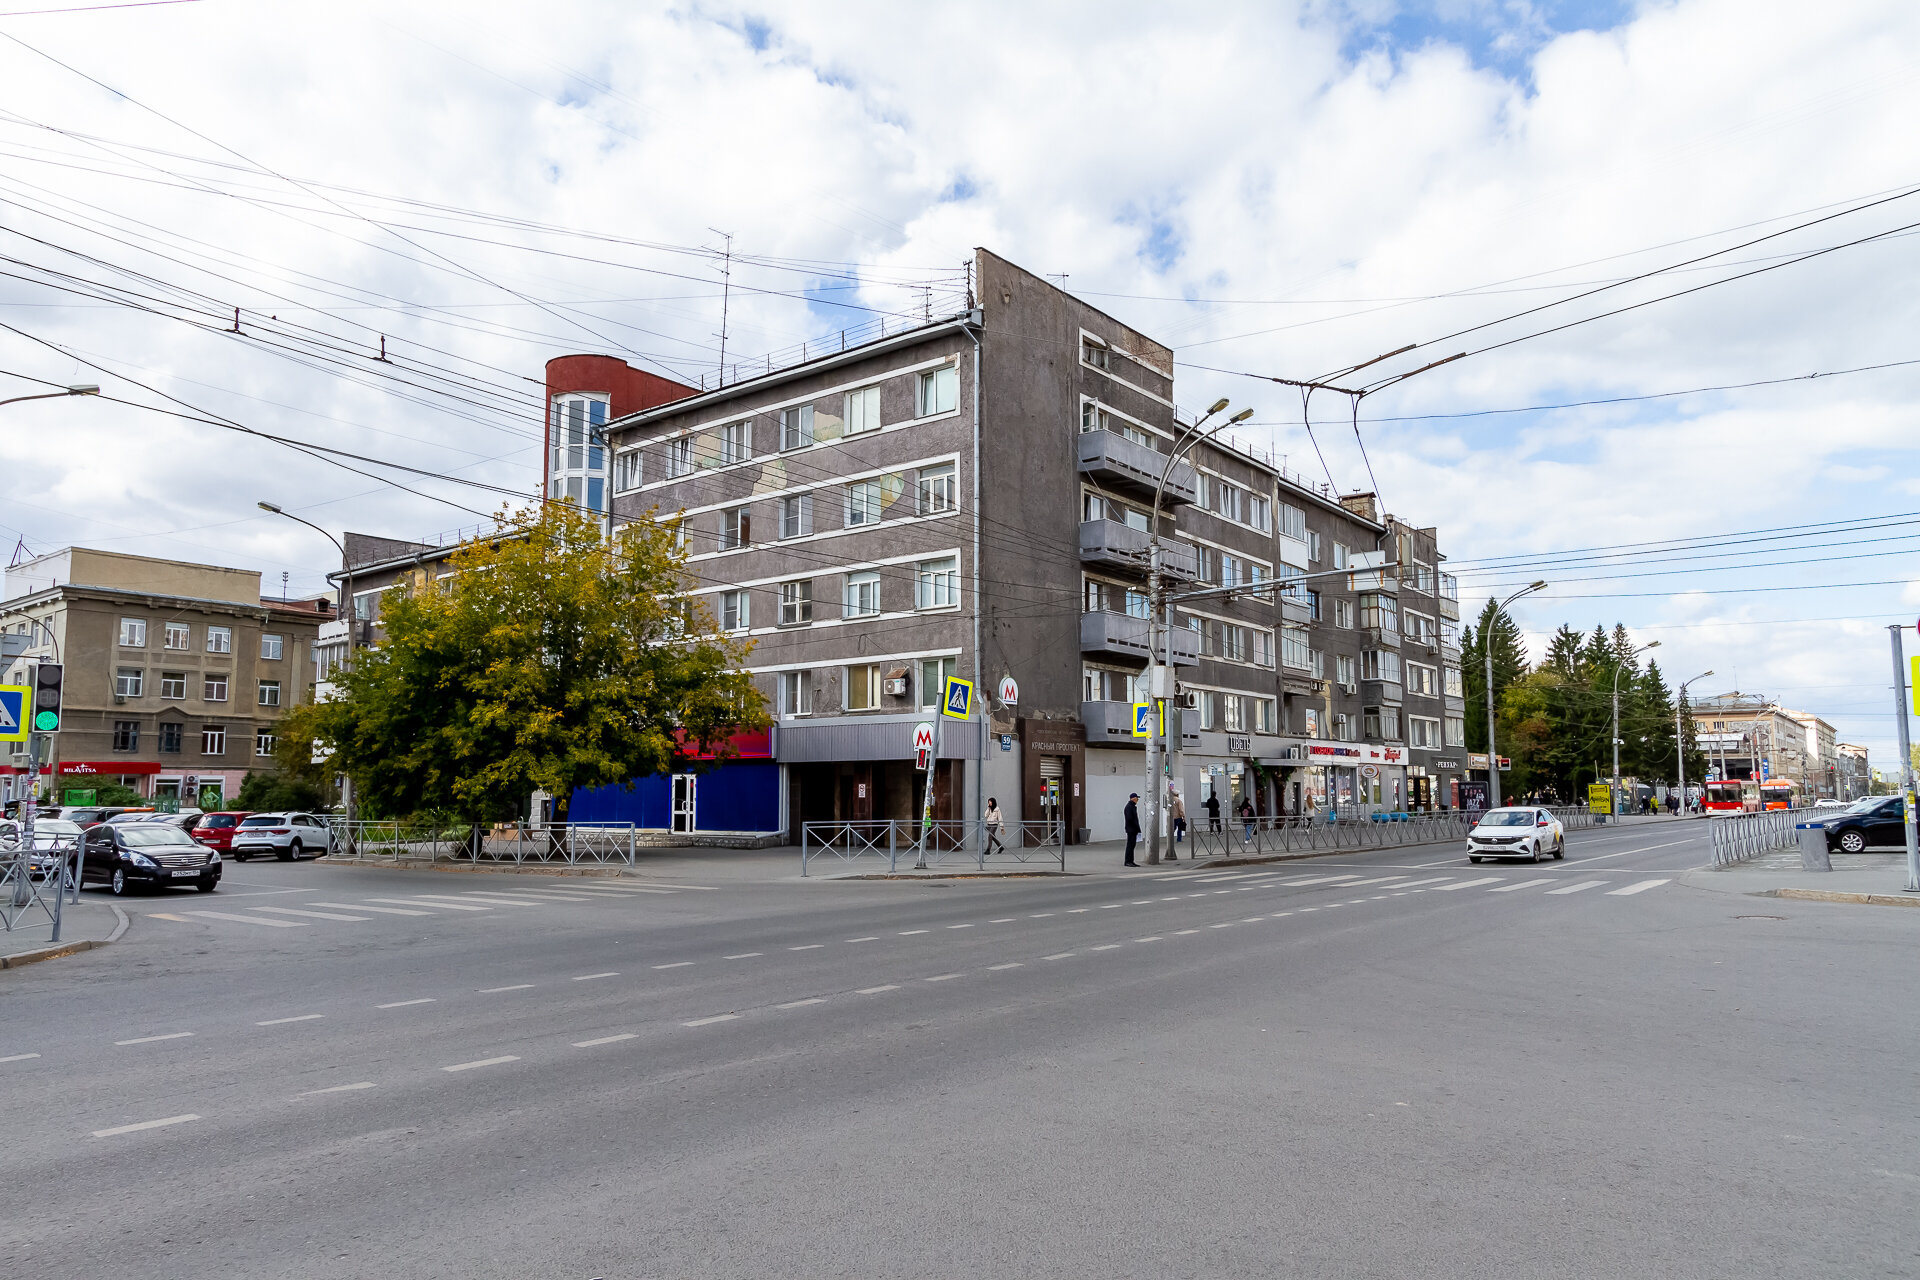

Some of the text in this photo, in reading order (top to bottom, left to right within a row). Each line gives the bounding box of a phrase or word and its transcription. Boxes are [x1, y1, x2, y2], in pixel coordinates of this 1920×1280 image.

[916, 730, 932, 746] М
[1003, 736, 1011, 745] 59
[64, 765, 97, 773] MILAVITSA
